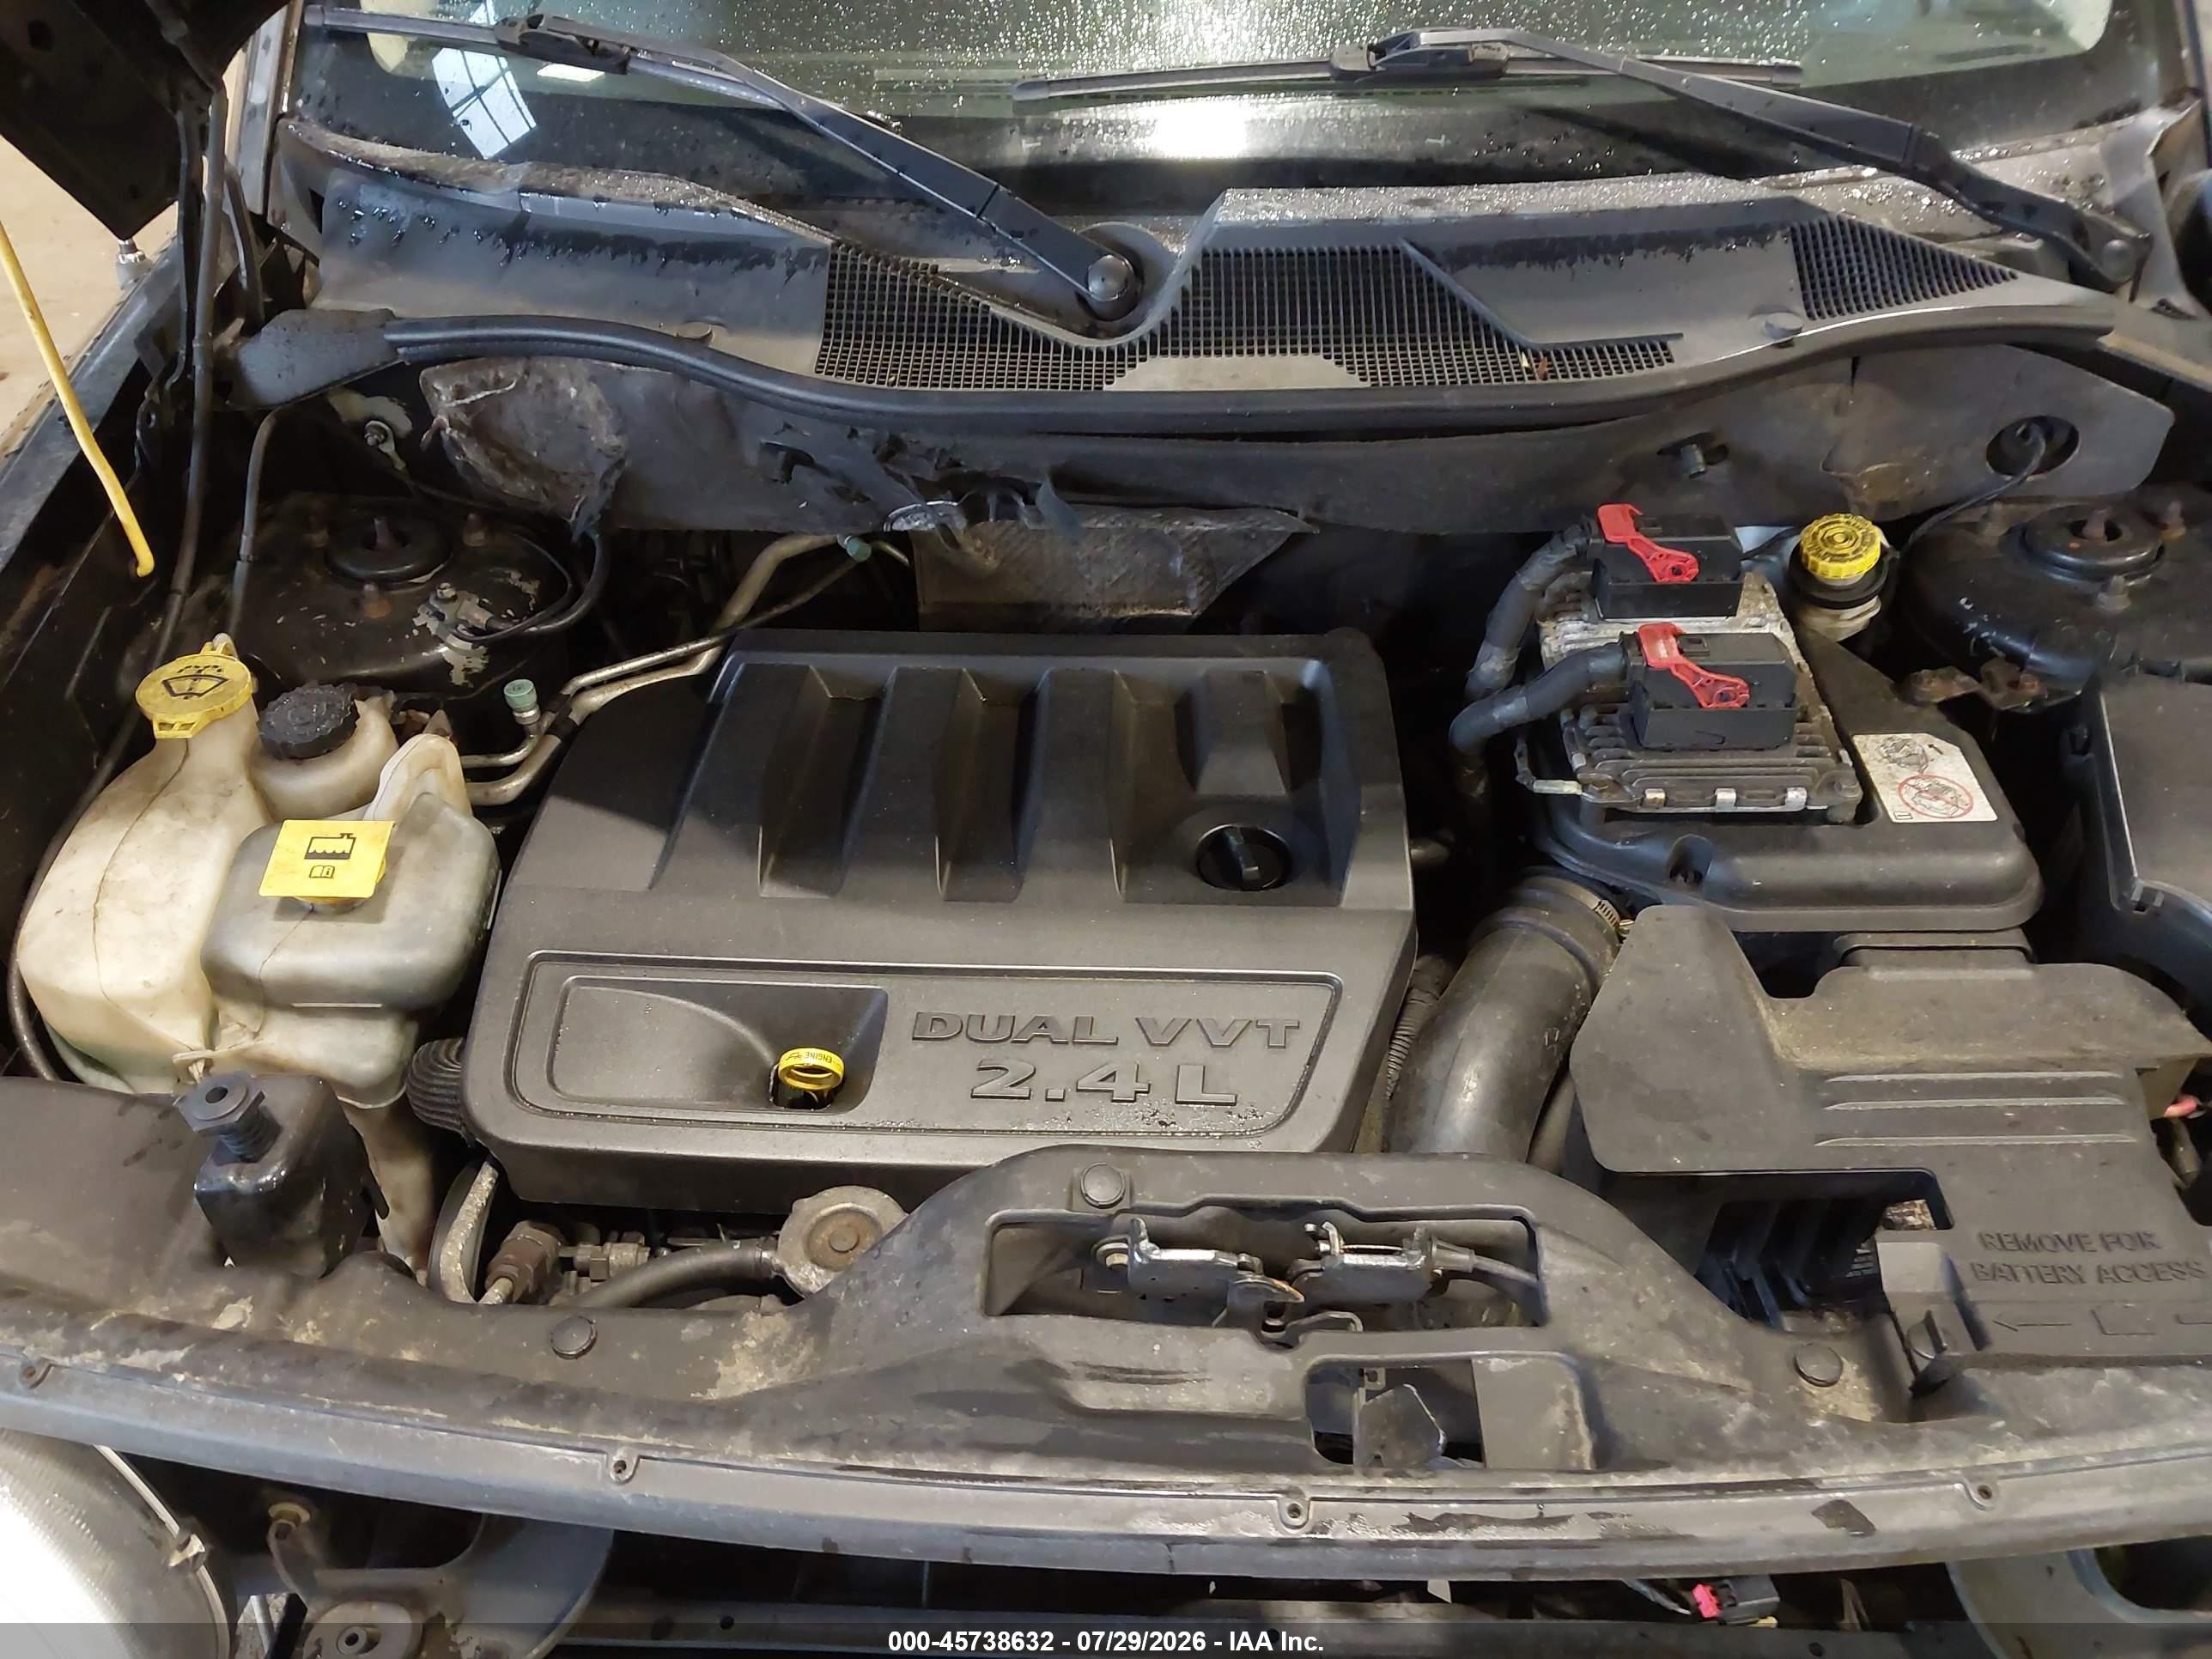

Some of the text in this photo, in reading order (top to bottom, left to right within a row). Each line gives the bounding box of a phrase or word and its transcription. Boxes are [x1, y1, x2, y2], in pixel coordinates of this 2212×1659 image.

[912, 1011, 1300, 1049] DUAL VVT
[805, 1051, 833, 1064] ENGINE
[1978, 1231, 2163, 1253] REMOVE FOR
[1971, 1261, 2206, 1285] BATTERY ACCESS
